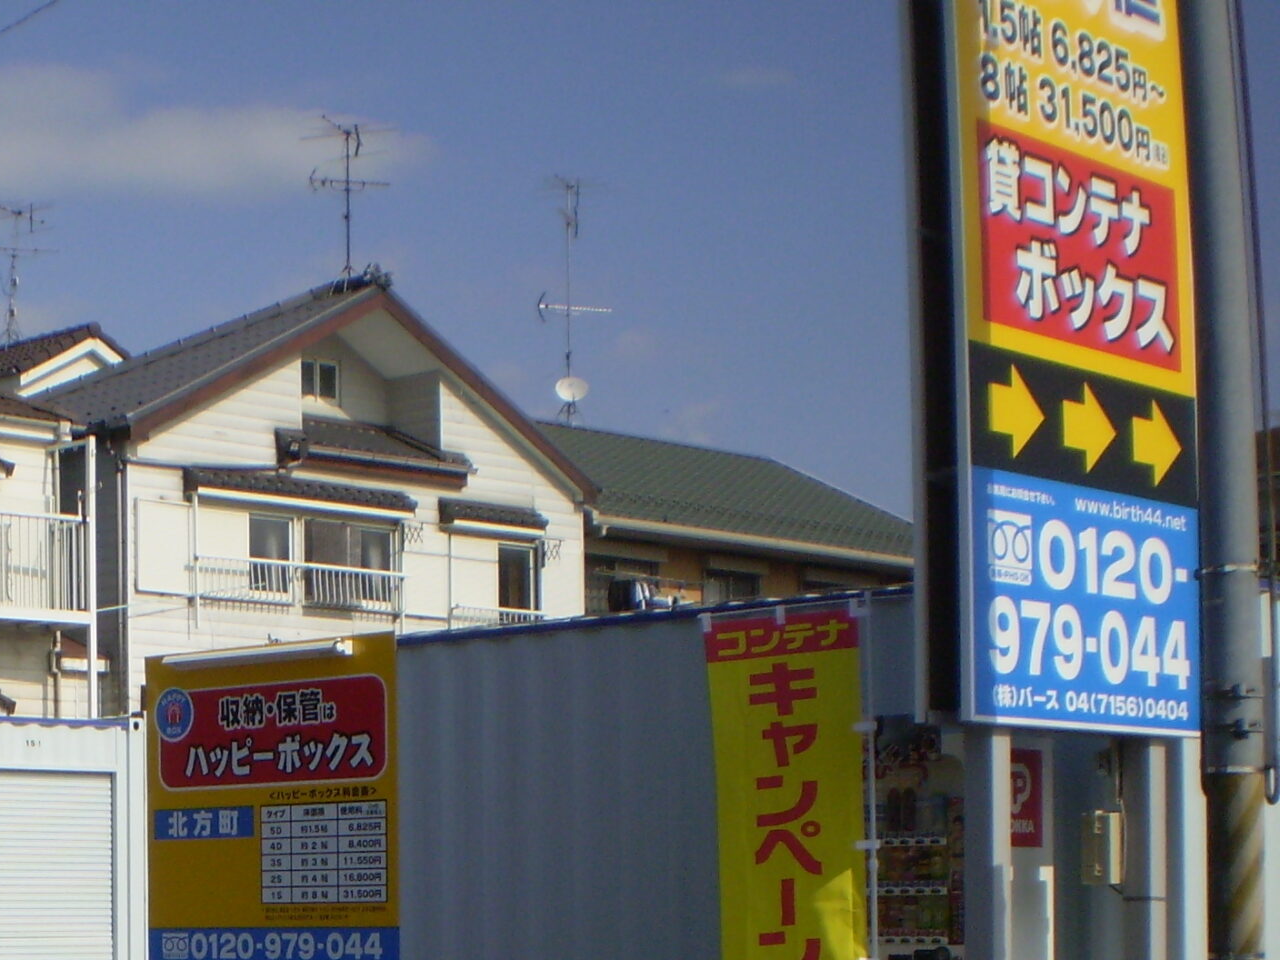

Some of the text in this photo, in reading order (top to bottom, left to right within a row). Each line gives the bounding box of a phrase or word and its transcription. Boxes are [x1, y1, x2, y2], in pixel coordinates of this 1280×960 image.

[980, 54, 1029, 116] 8帖
[986, 138, 1151, 256] 貸コンテナ
[1016, 240, 1174, 353] ボックス
[1075, 497, 1187, 532] www.birth44.net
[1039, 519, 1187, 604] 0120-
[717, 619, 849, 656] コンテナ
[988, 596, 1191, 690] 979-044
[1065, 691, 1188, 721] 04(7156)0404
[185, 733, 373, 777] ハッピーボックス
[168, 810, 240, 837] 北方町
[190, 932, 383, 960] 0120-979-044
